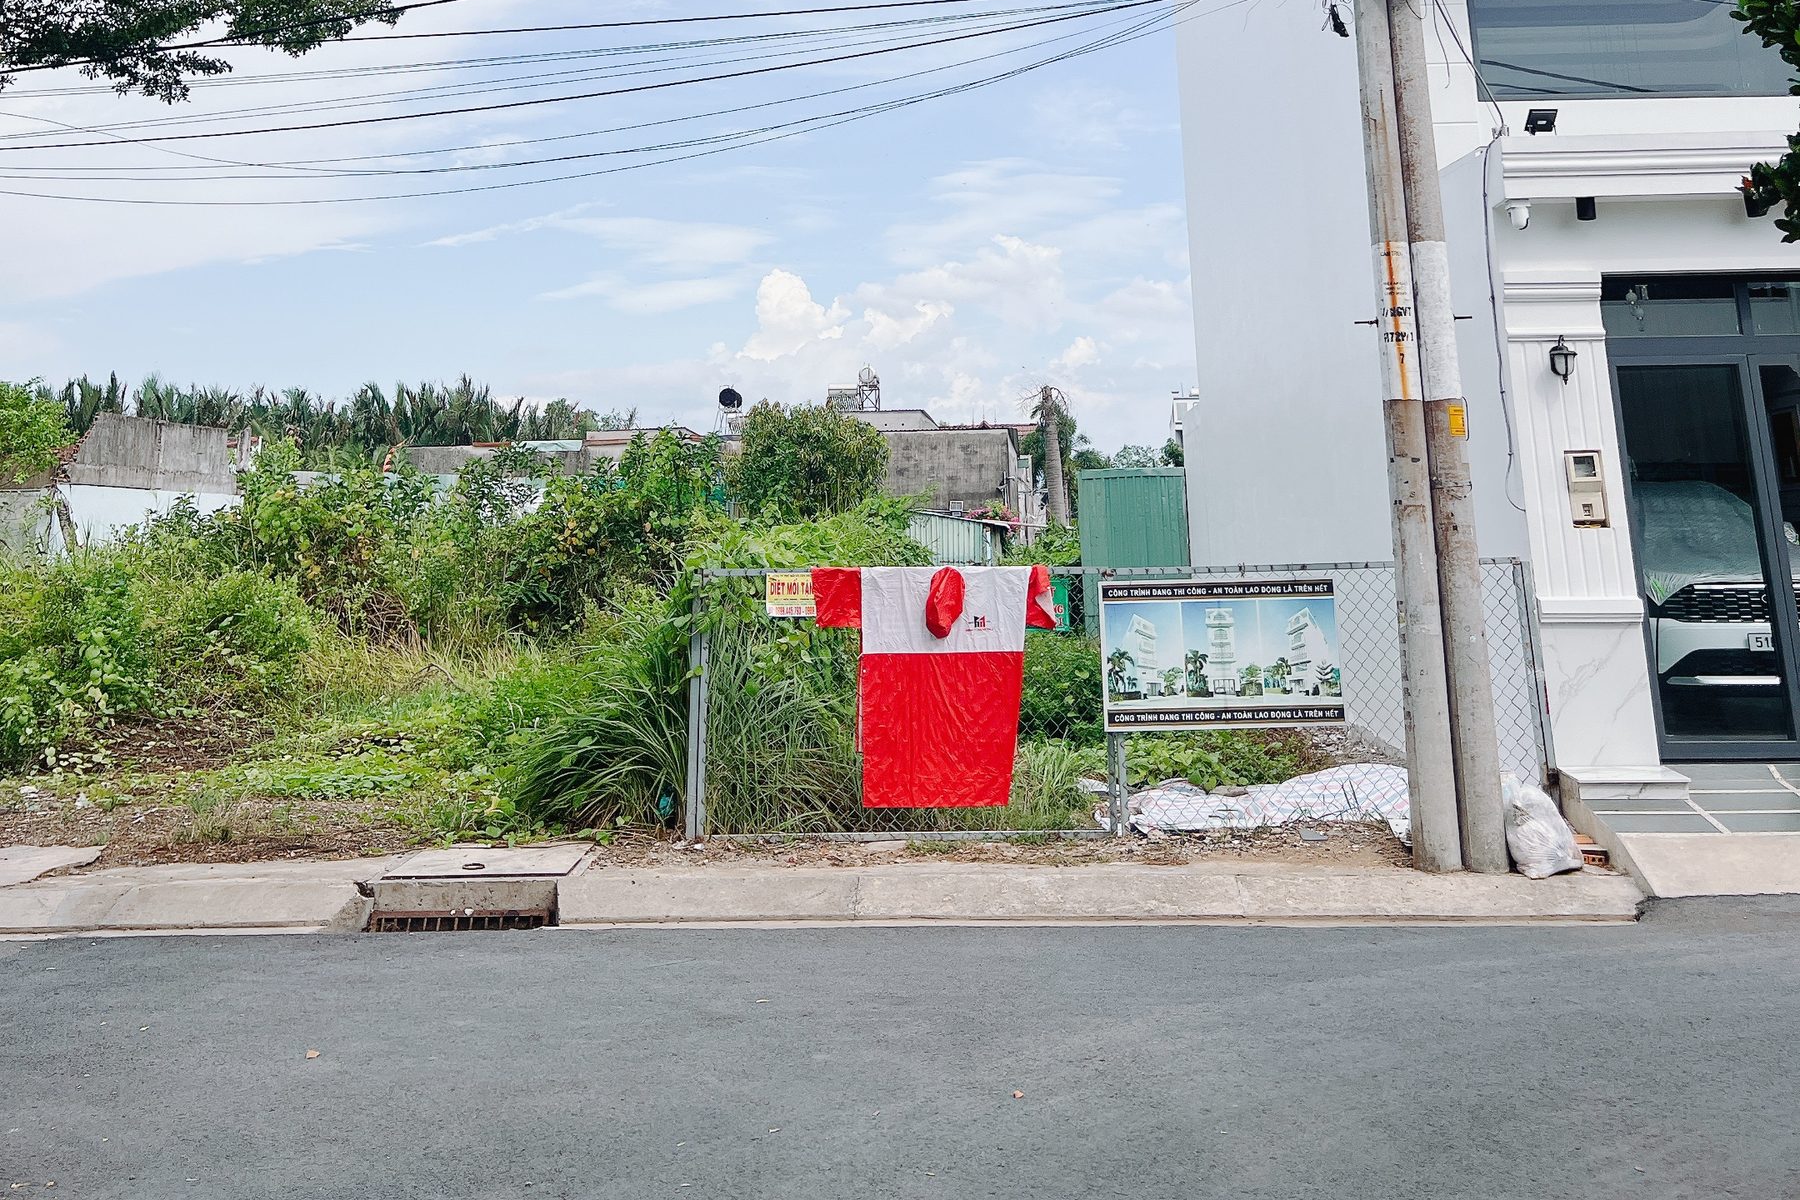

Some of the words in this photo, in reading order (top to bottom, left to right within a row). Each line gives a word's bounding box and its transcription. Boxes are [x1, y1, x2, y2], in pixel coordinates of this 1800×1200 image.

[1108, 589, 1128, 597] CÔNG
[1130, 587, 1151, 596] TRÌNH
[1152, 588, 1172, 596] ĐANG
[1186, 587, 1206, 595] CÔNG
[1224, 586, 1243, 594] TOÀN
[1245, 586, 1259, 594] LAO
[1261, 585, 1281, 595] ĐỘNG
[1283, 584, 1293, 592] LÀ
[1294, 584, 1313, 592] TRÊN
[1114, 714, 1135, 722] CÔNG
[1136, 713, 1158, 721] TRÌNH
[1159, 713, 1180, 721] ĐANG
[1194, 712, 1215, 720] CÔNG
[1233, 711, 1252, 719] TOÀN
[1270, 710, 1292, 719] ĐỘNG
[1293, 709, 1303, 717] LÀ
[1304, 709, 1323, 717] TRÊN
